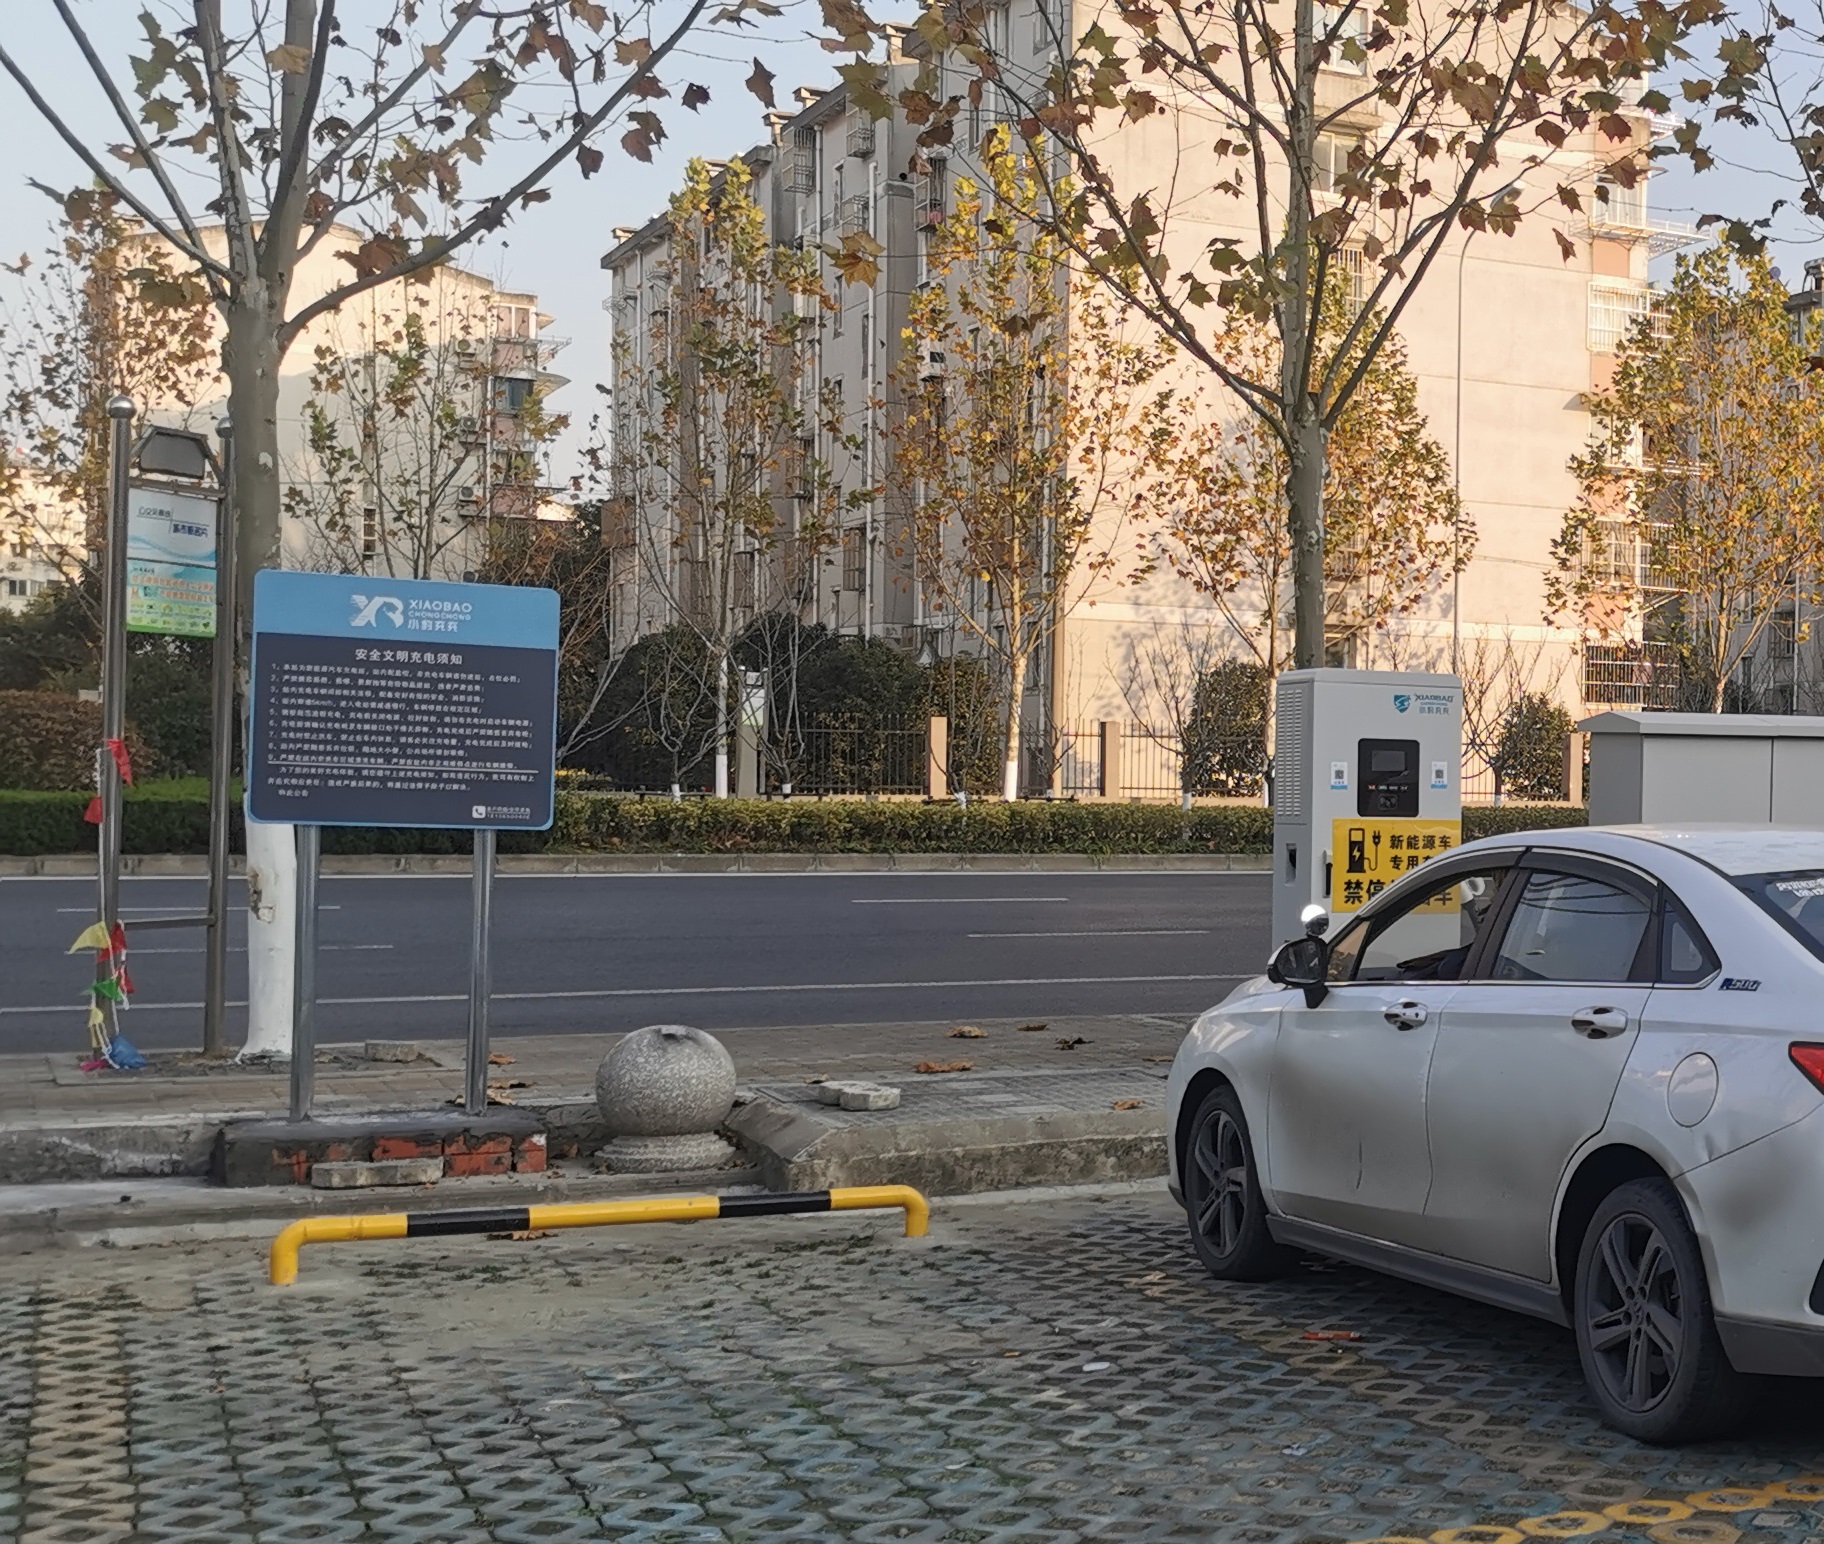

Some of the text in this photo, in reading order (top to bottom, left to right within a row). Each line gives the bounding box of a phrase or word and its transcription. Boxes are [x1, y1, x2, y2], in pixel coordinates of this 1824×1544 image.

[408, 599, 473, 613] XIAOBAO
[355, 648, 463, 666] 安全文明充电须知
[1389, 834, 1452, 851] 新能源车
